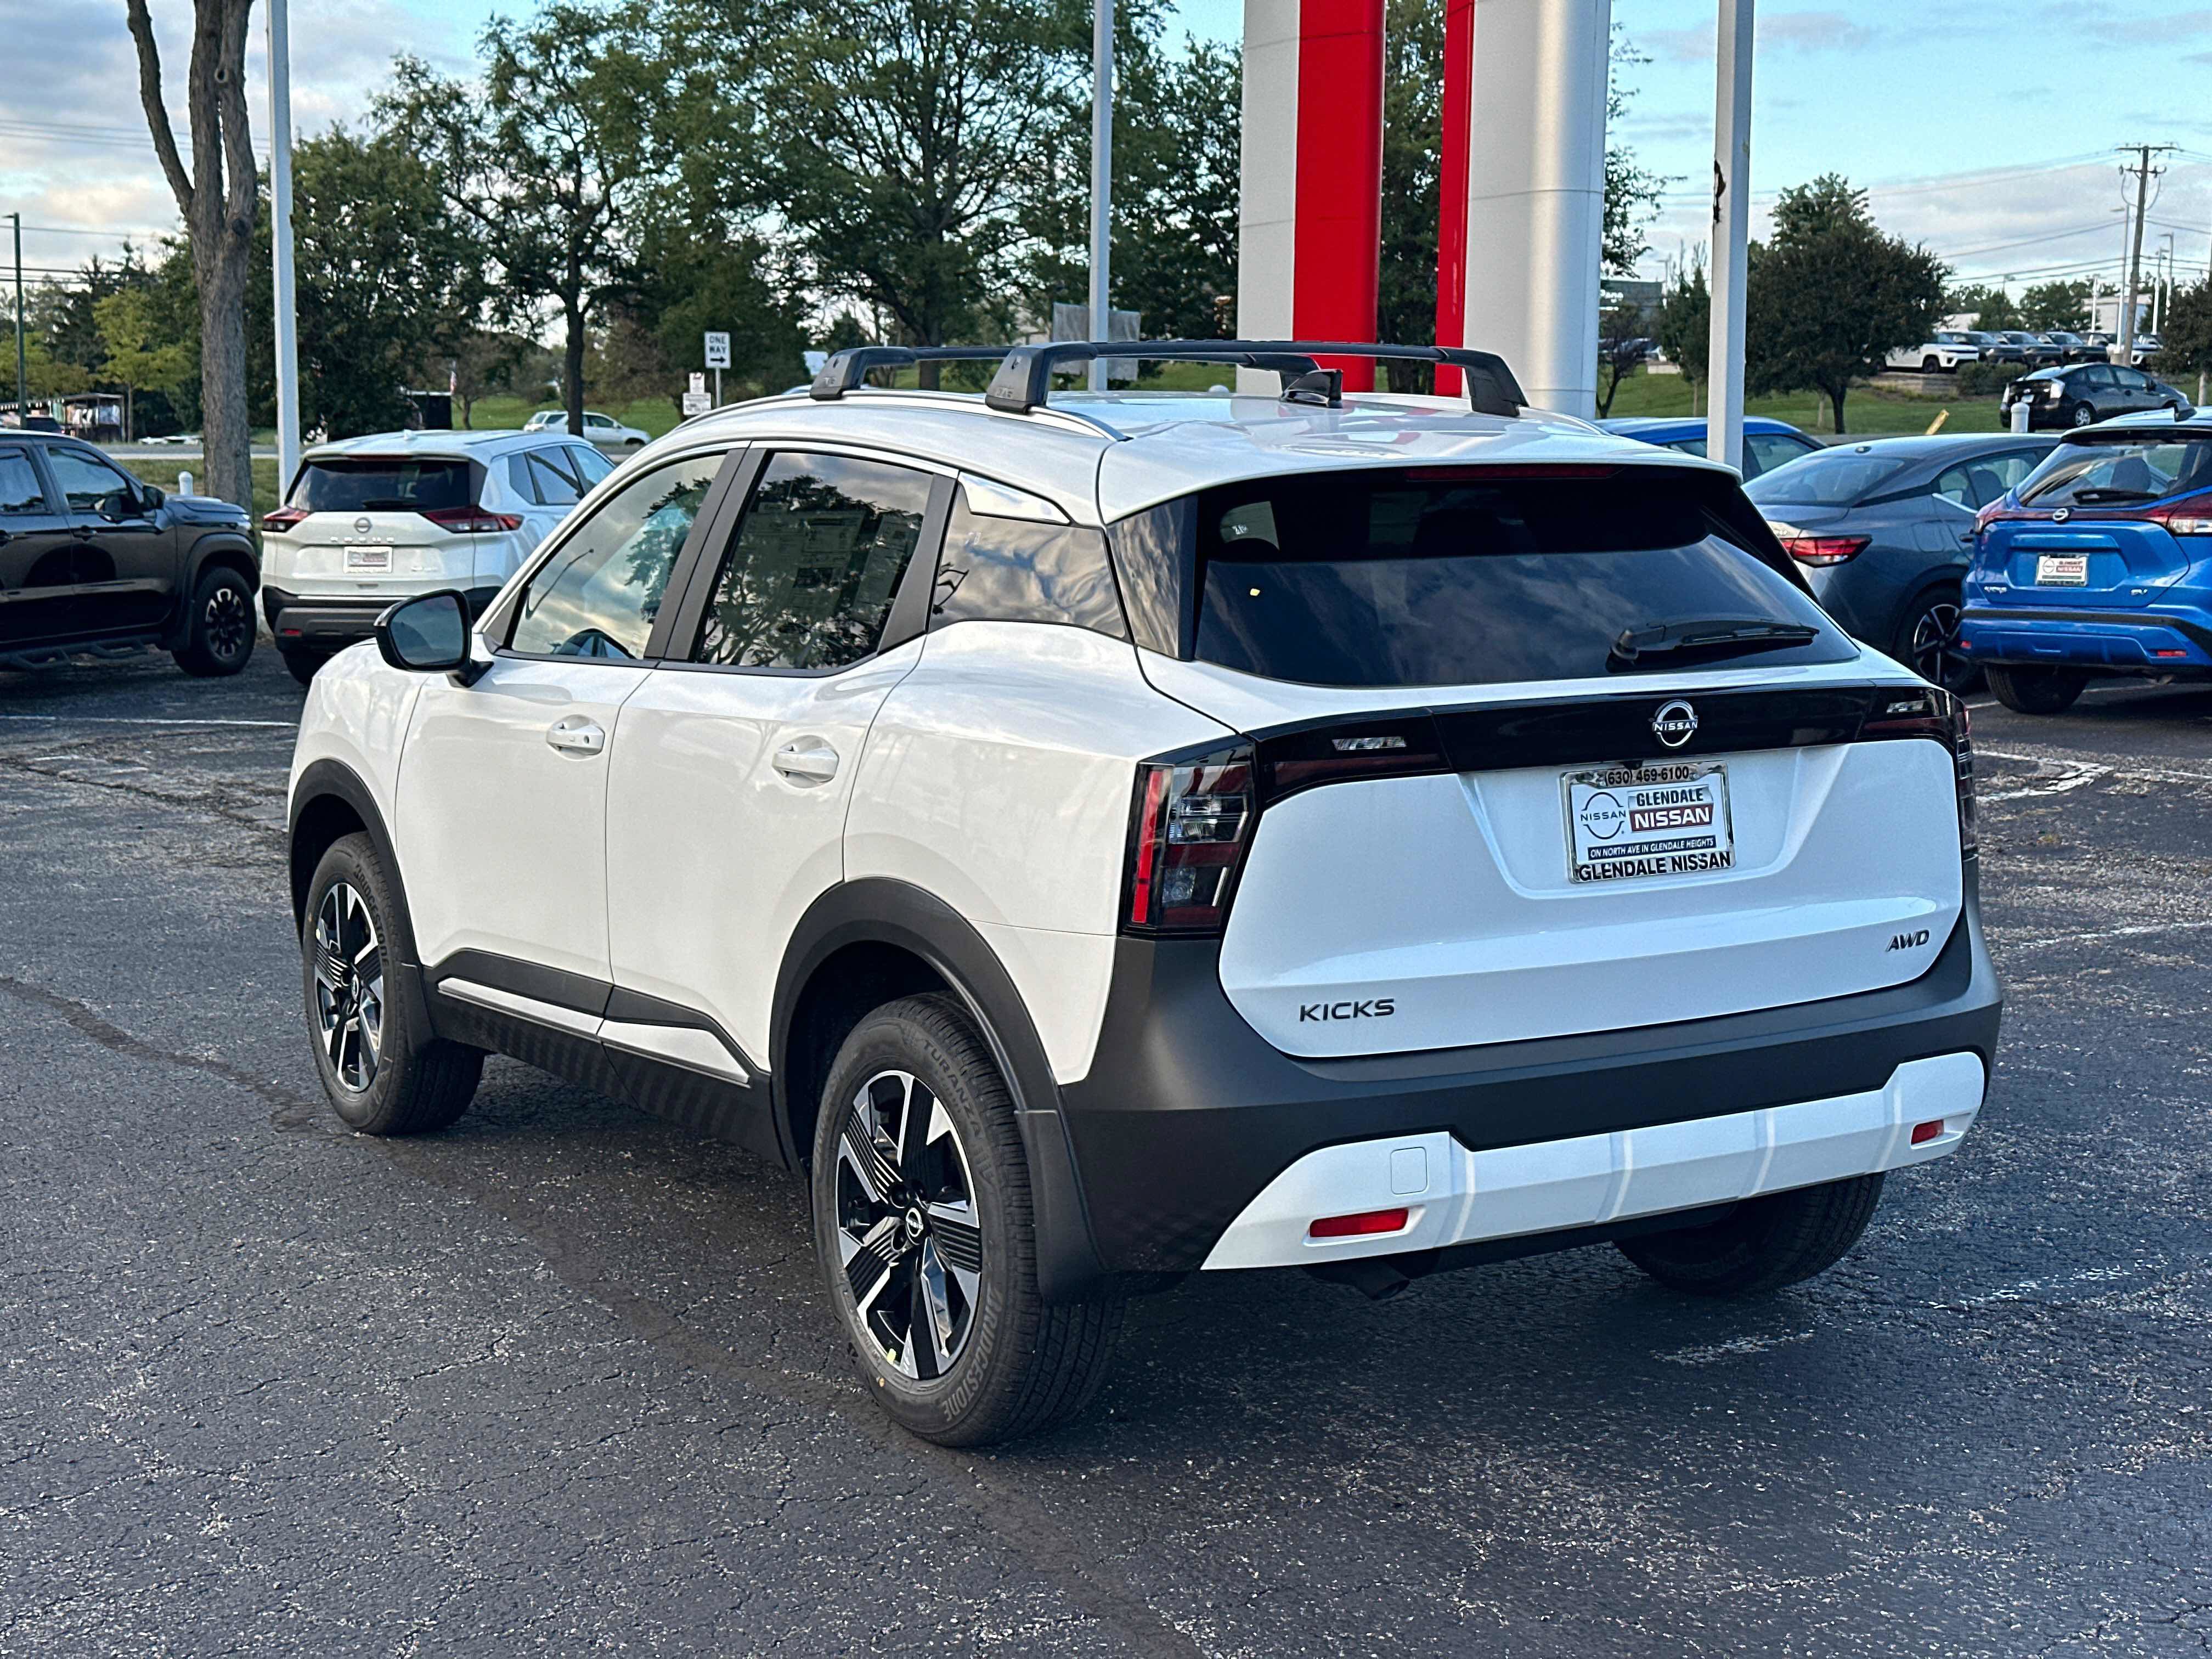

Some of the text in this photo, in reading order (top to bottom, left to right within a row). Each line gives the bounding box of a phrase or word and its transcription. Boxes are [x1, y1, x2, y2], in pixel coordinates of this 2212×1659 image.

[709, 336, 726, 345] ONE
[1654, 720, 1698, 731] NISSAN
[1605, 766, 1690, 786] (630) 469-6100
[1637, 788, 1703, 807] GLENDALE
[1581, 810, 1626, 821] NISSAN
[1634, 806, 1711, 829] NISSAN
[1591, 837, 1714, 857] ON NORTH AVE IN GLENDALE HEIGHTS
[1579, 851, 1731, 881] GLENDALE NISSAN
[1884, 929, 1929, 952] AWD
[1299, 998, 1395, 1022] KICKS
[923, 1040, 982, 1137] TURANZA
[942, 1284, 1003, 1422] BRIDGESTONE
